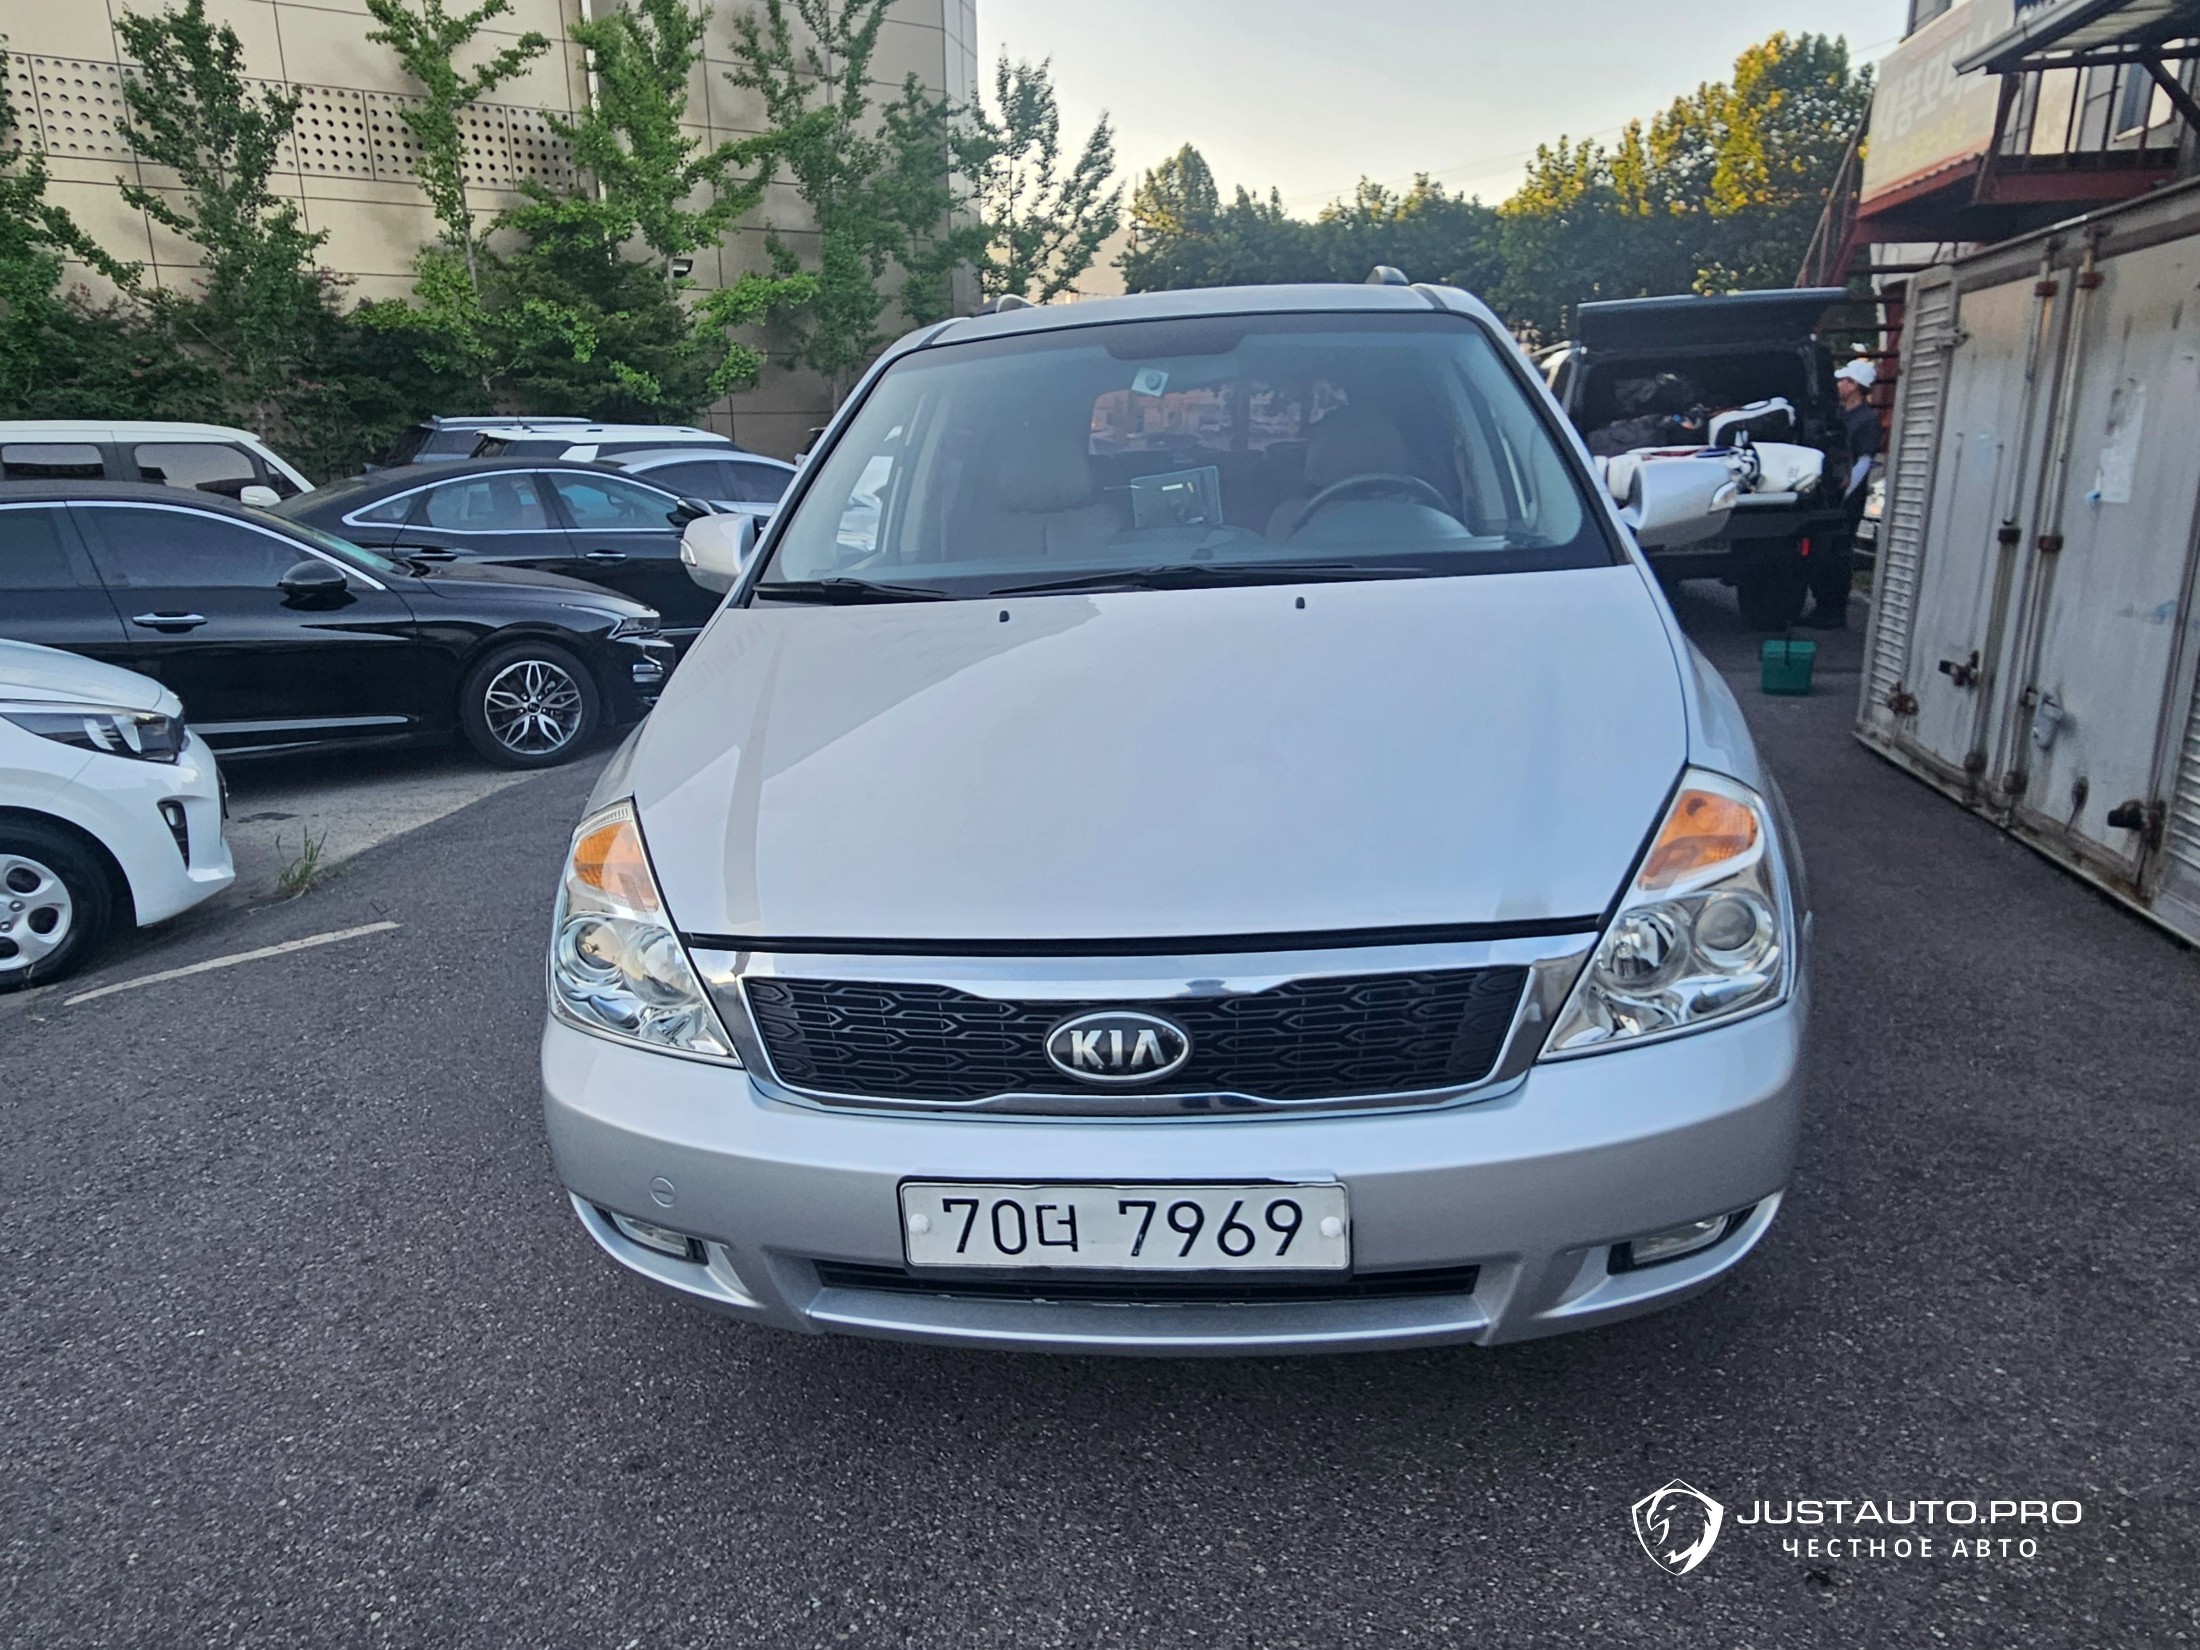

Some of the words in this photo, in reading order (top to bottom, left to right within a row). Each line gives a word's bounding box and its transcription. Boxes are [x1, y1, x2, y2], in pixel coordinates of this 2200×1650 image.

[1070, 1029, 1166, 1066] KIA
[941, 1198, 1079, 1255] 70더
[1117, 1198, 1303, 1257] 7969
